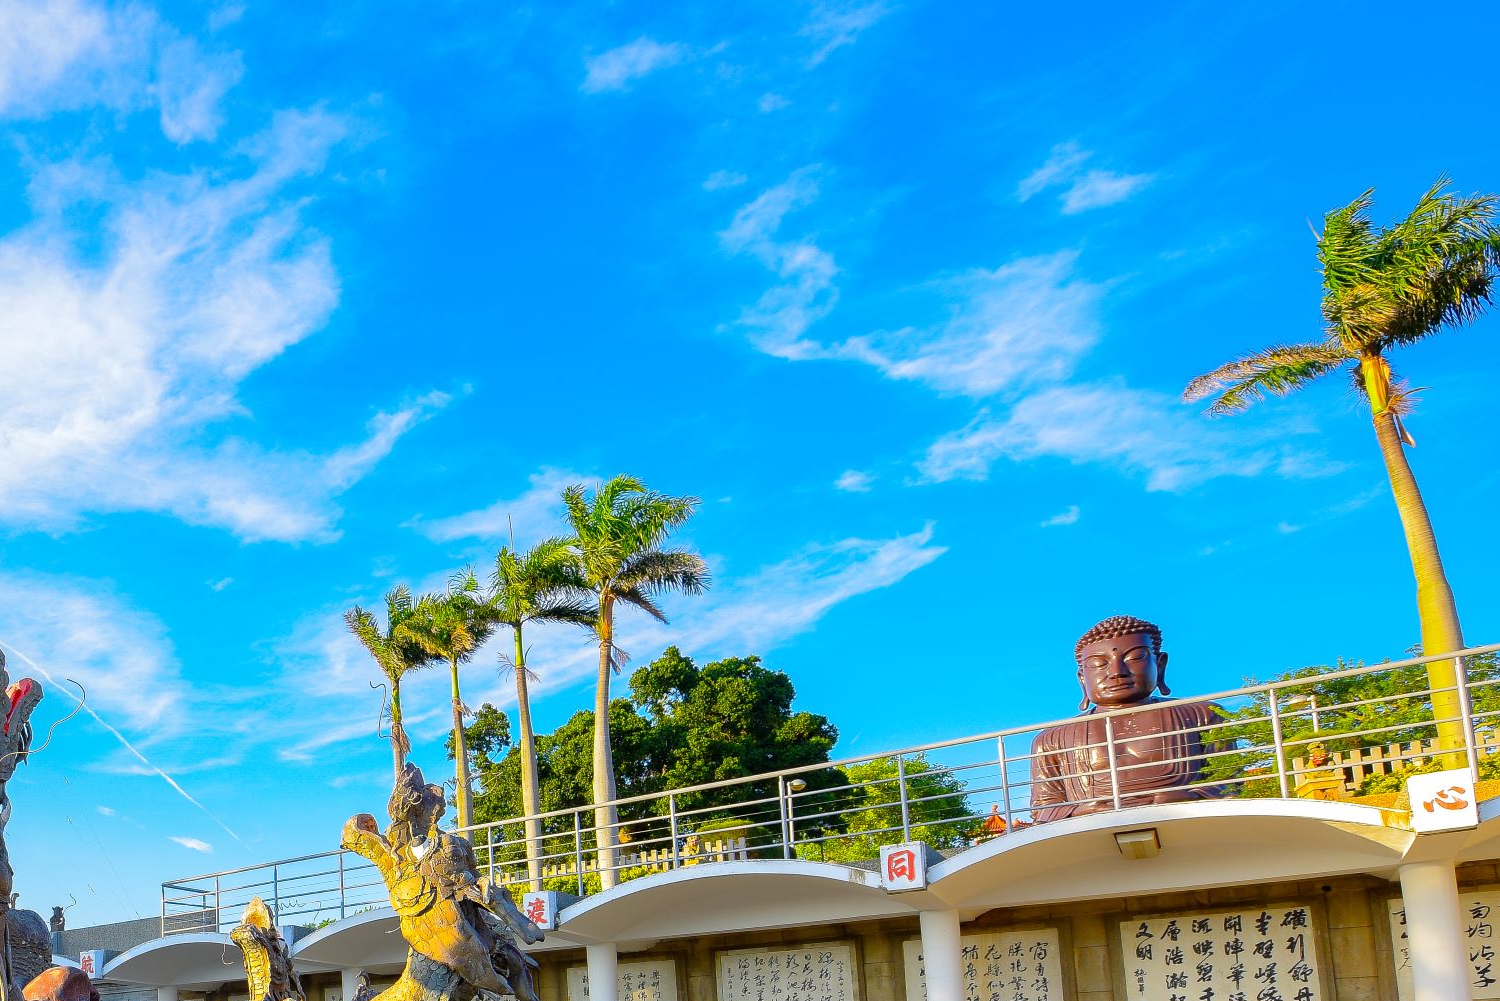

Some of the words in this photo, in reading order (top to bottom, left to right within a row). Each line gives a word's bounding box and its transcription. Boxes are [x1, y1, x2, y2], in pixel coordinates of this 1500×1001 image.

[1423, 786, 1469, 813] 心
[887, 850, 916, 882] 同
[527, 897, 548, 924] 渡
[1135, 922, 1153, 961] 文明
